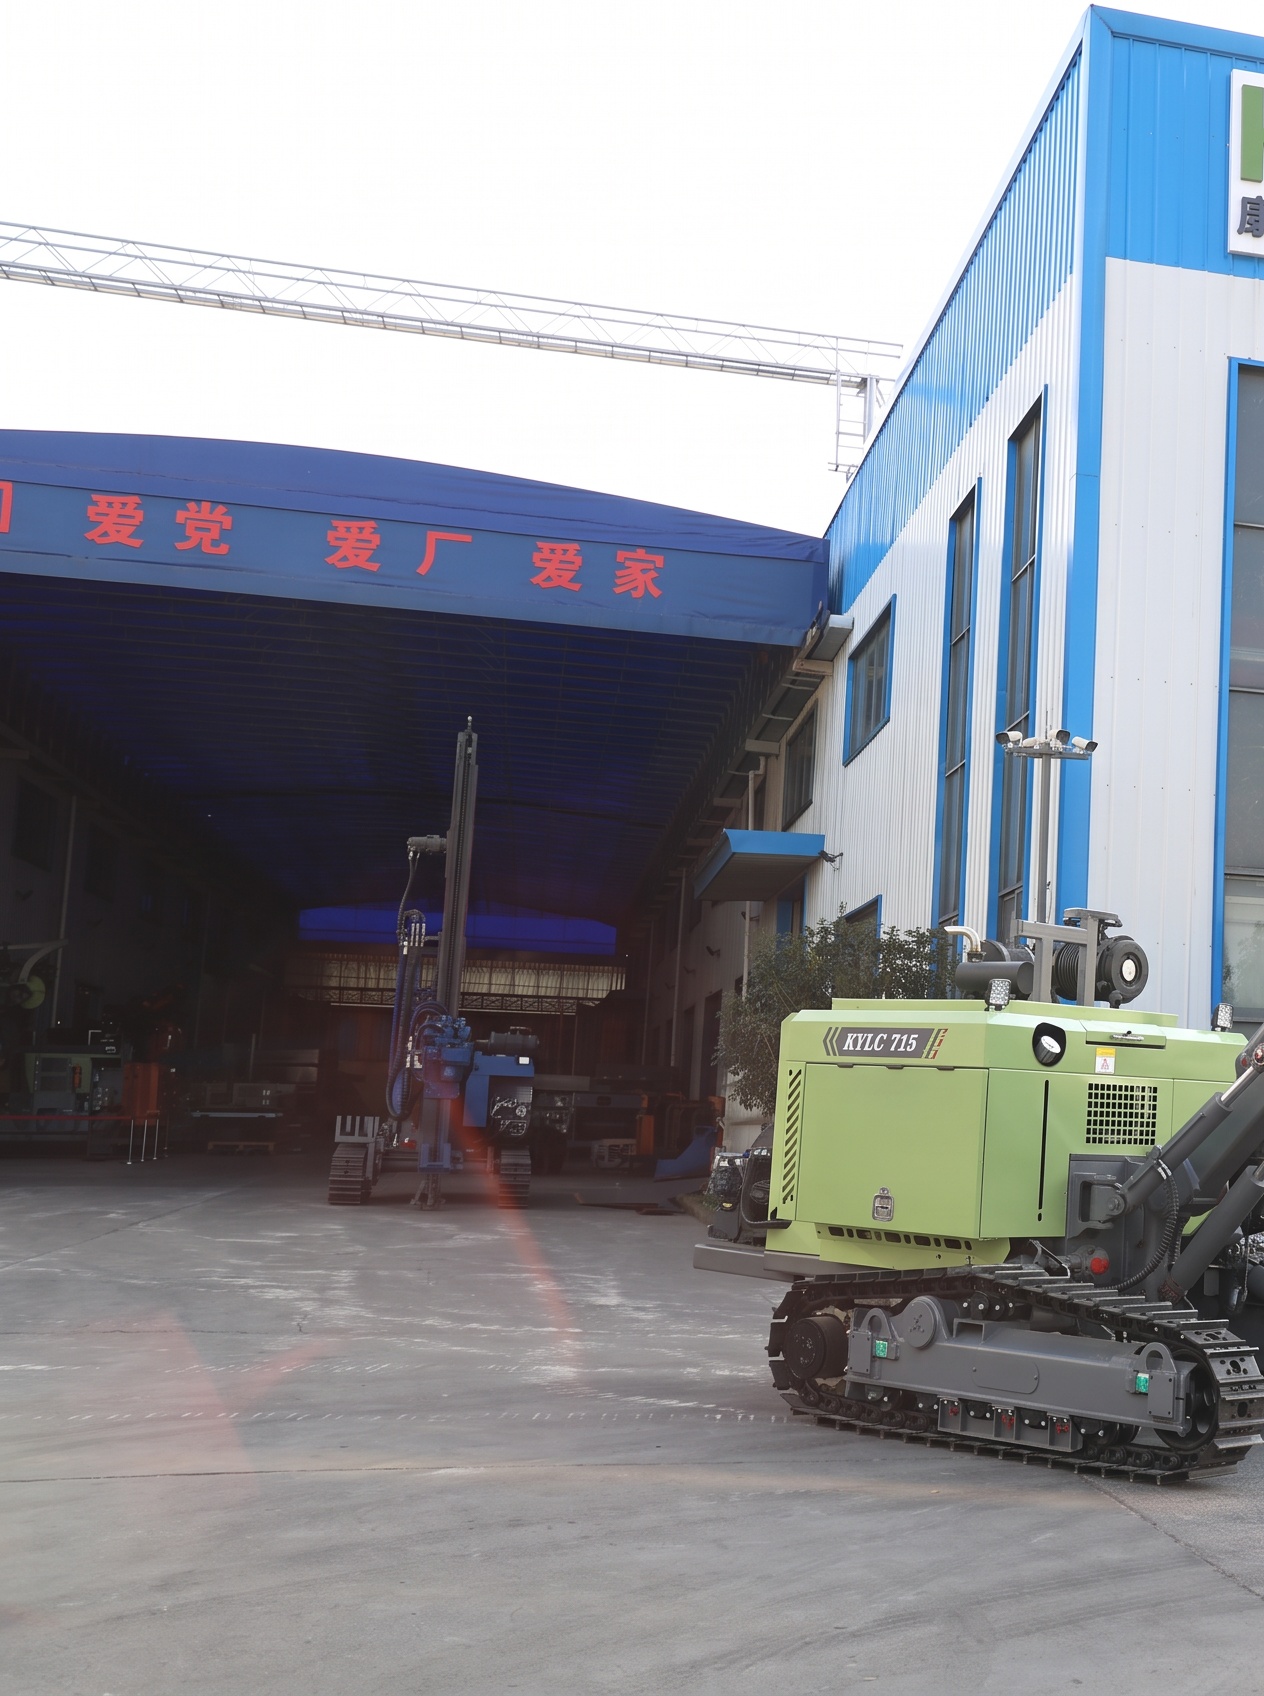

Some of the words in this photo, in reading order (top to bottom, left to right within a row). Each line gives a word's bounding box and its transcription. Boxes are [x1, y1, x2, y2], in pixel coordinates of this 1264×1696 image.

[83, 493, 233, 555] 爱党
[324, 519, 473, 576] 爱厂
[529, 541, 665, 599] 爱家
[842, 1033, 887, 1051] KYLC
[890, 1033, 919, 1052] 715
